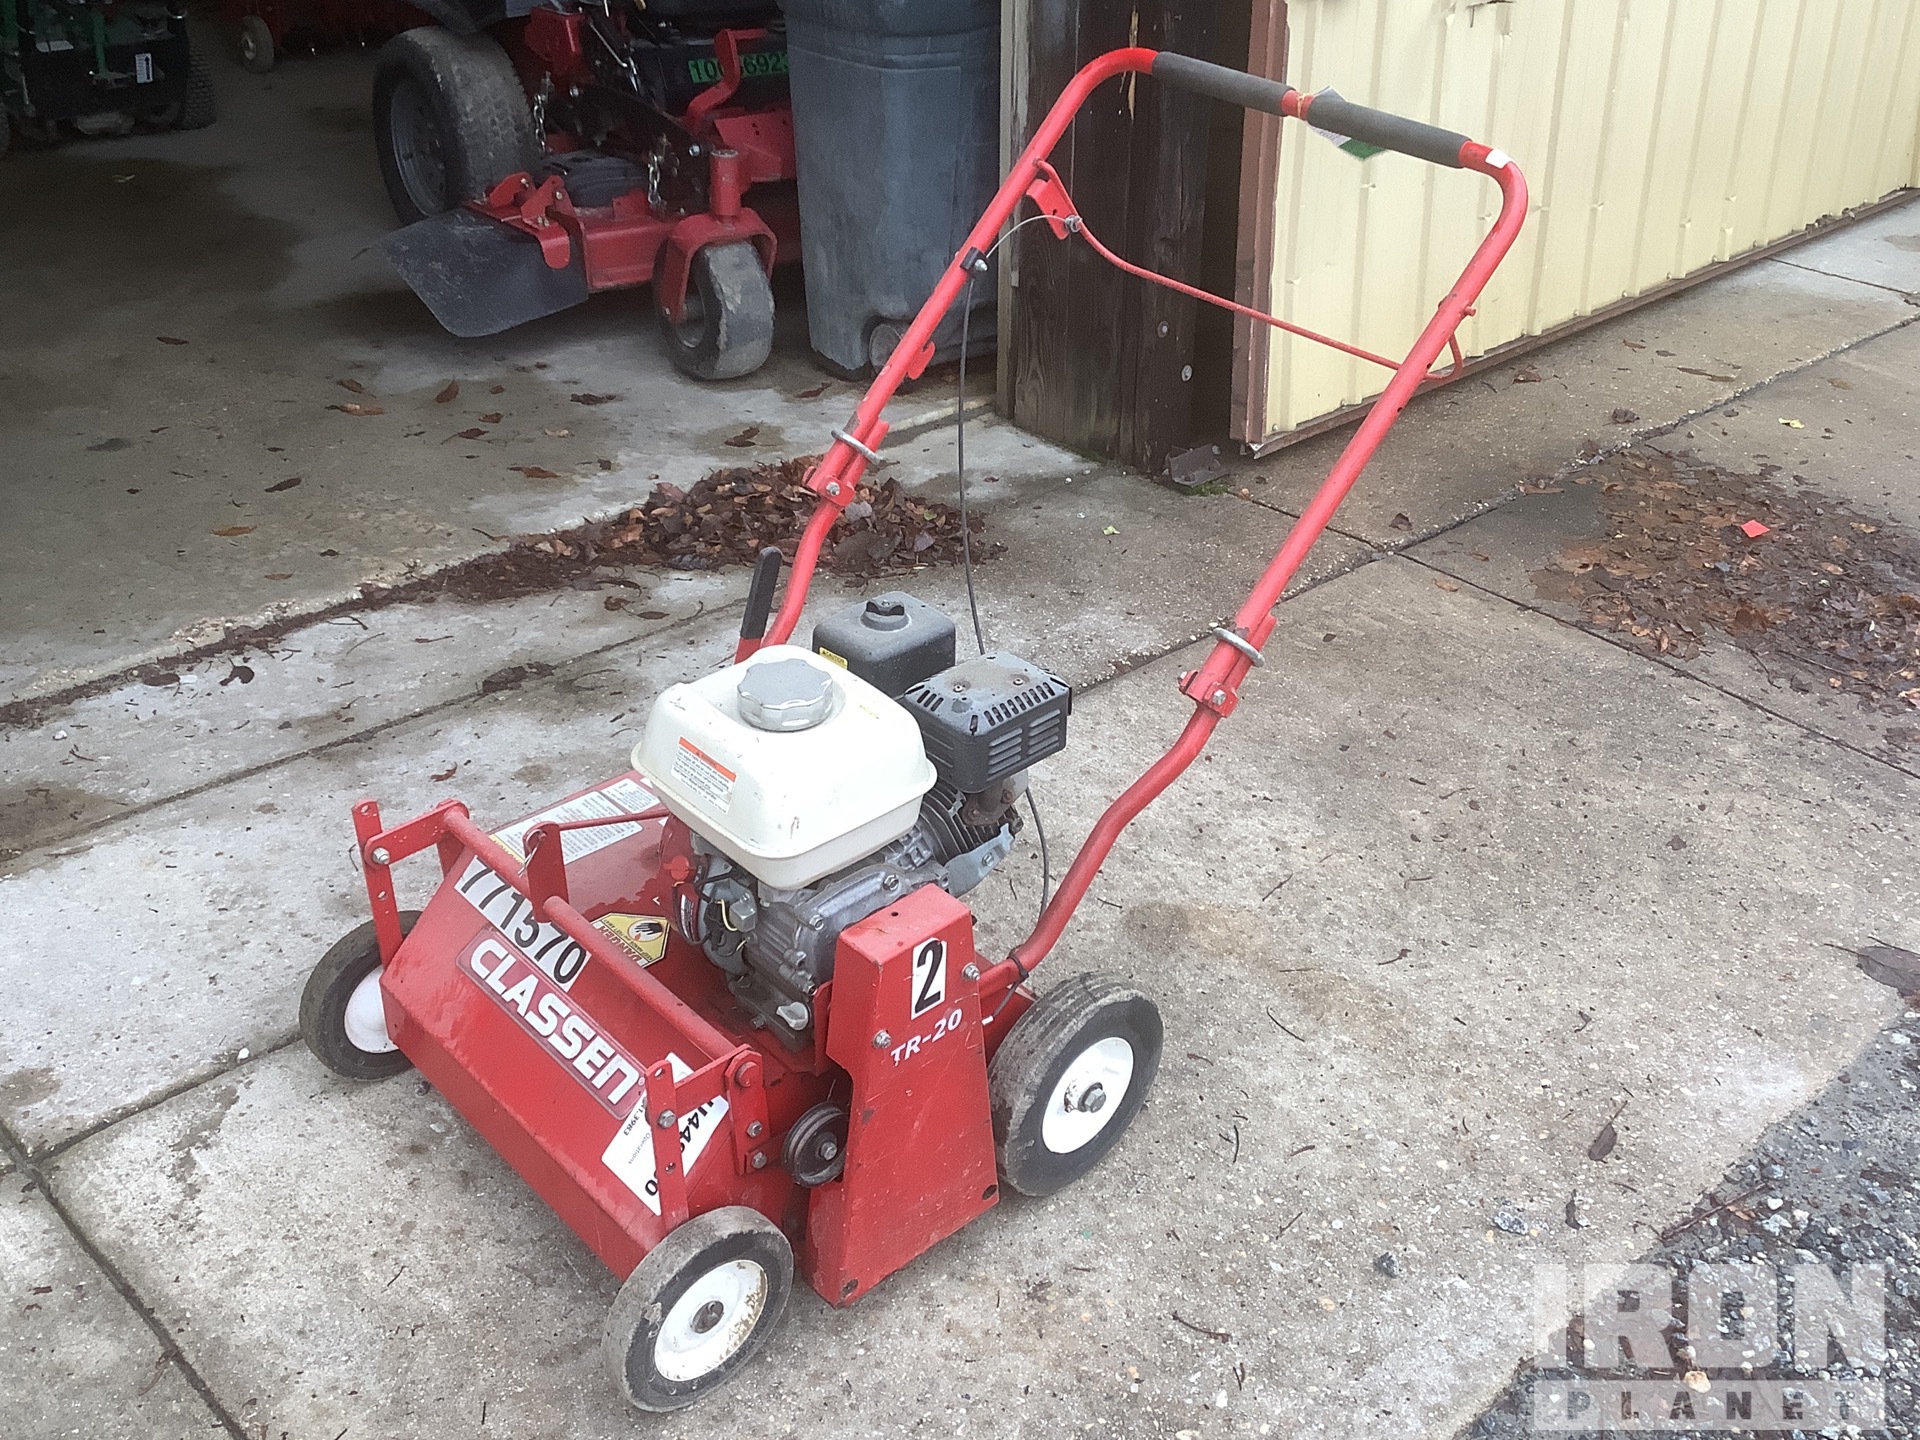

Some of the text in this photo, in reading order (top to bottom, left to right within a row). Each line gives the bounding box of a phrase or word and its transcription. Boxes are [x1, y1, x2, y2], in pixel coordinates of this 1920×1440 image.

[461, 857, 587, 984] 771570
[915, 940, 943, 1014] 2
[470, 939, 639, 1105] CLASSEN
[890, 1008, 963, 1066] TR-20
[627, 1132, 651, 1165] Operations
